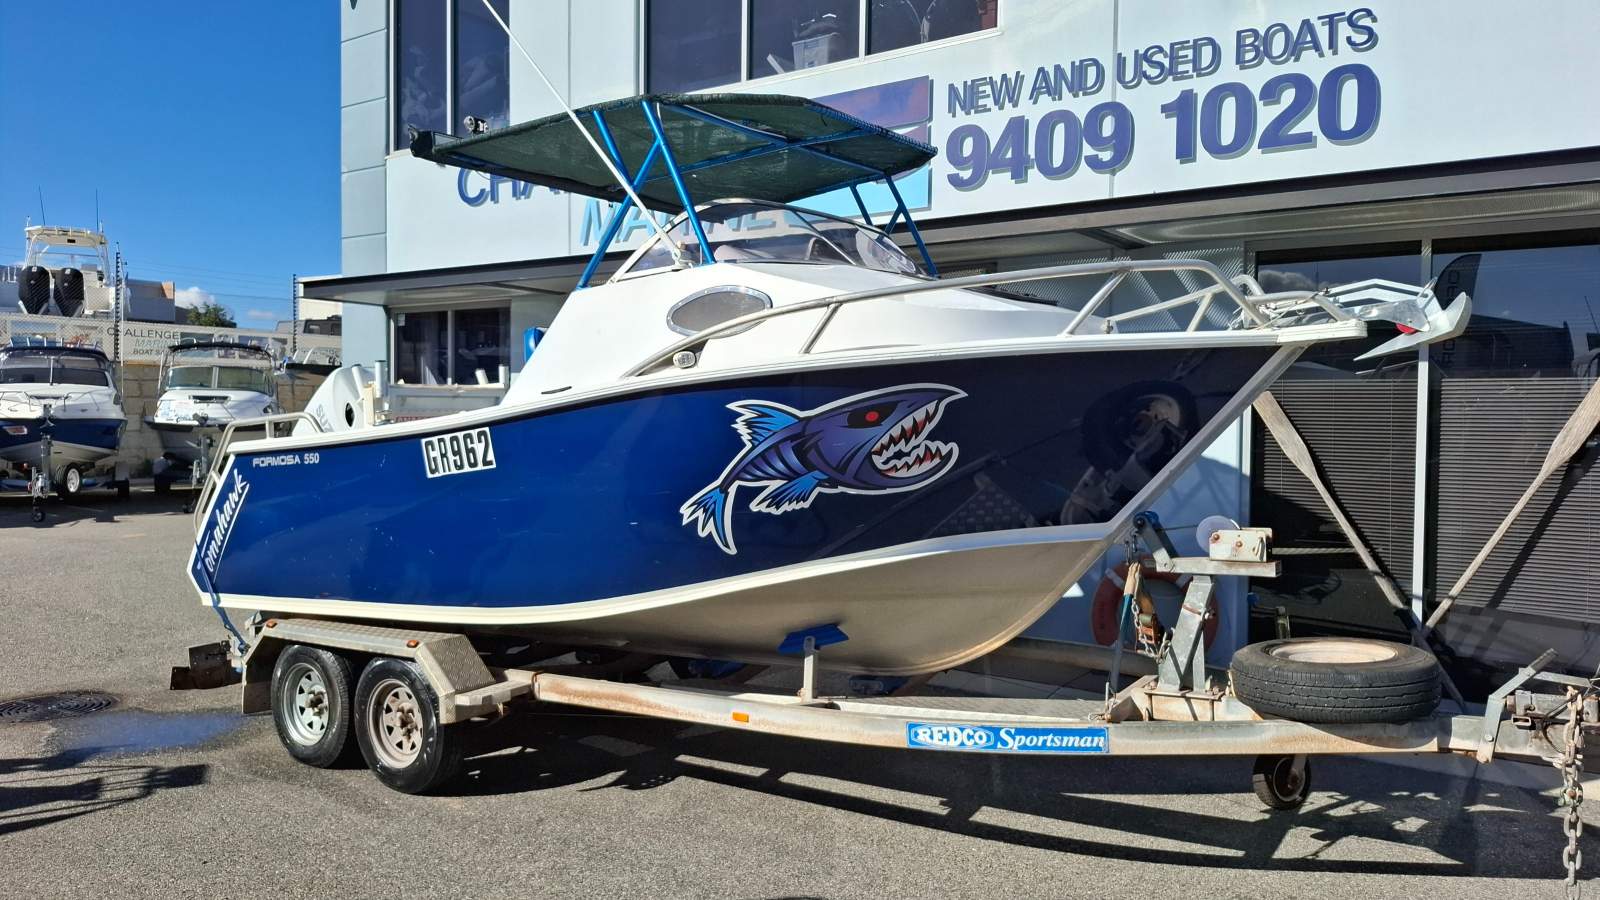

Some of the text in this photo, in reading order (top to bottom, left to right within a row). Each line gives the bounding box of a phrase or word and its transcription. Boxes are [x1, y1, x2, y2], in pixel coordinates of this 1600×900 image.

[947, 7, 1378, 118] NEW AND USED BOATS
[945, 63, 1382, 192] 9409 1020
[107, 326, 180, 340] CALLENGE
[252, 452, 320, 468] FORMOSA 550
[425, 430, 493, 475] GR962
[996, 727, 1105, 751] Sportsman
